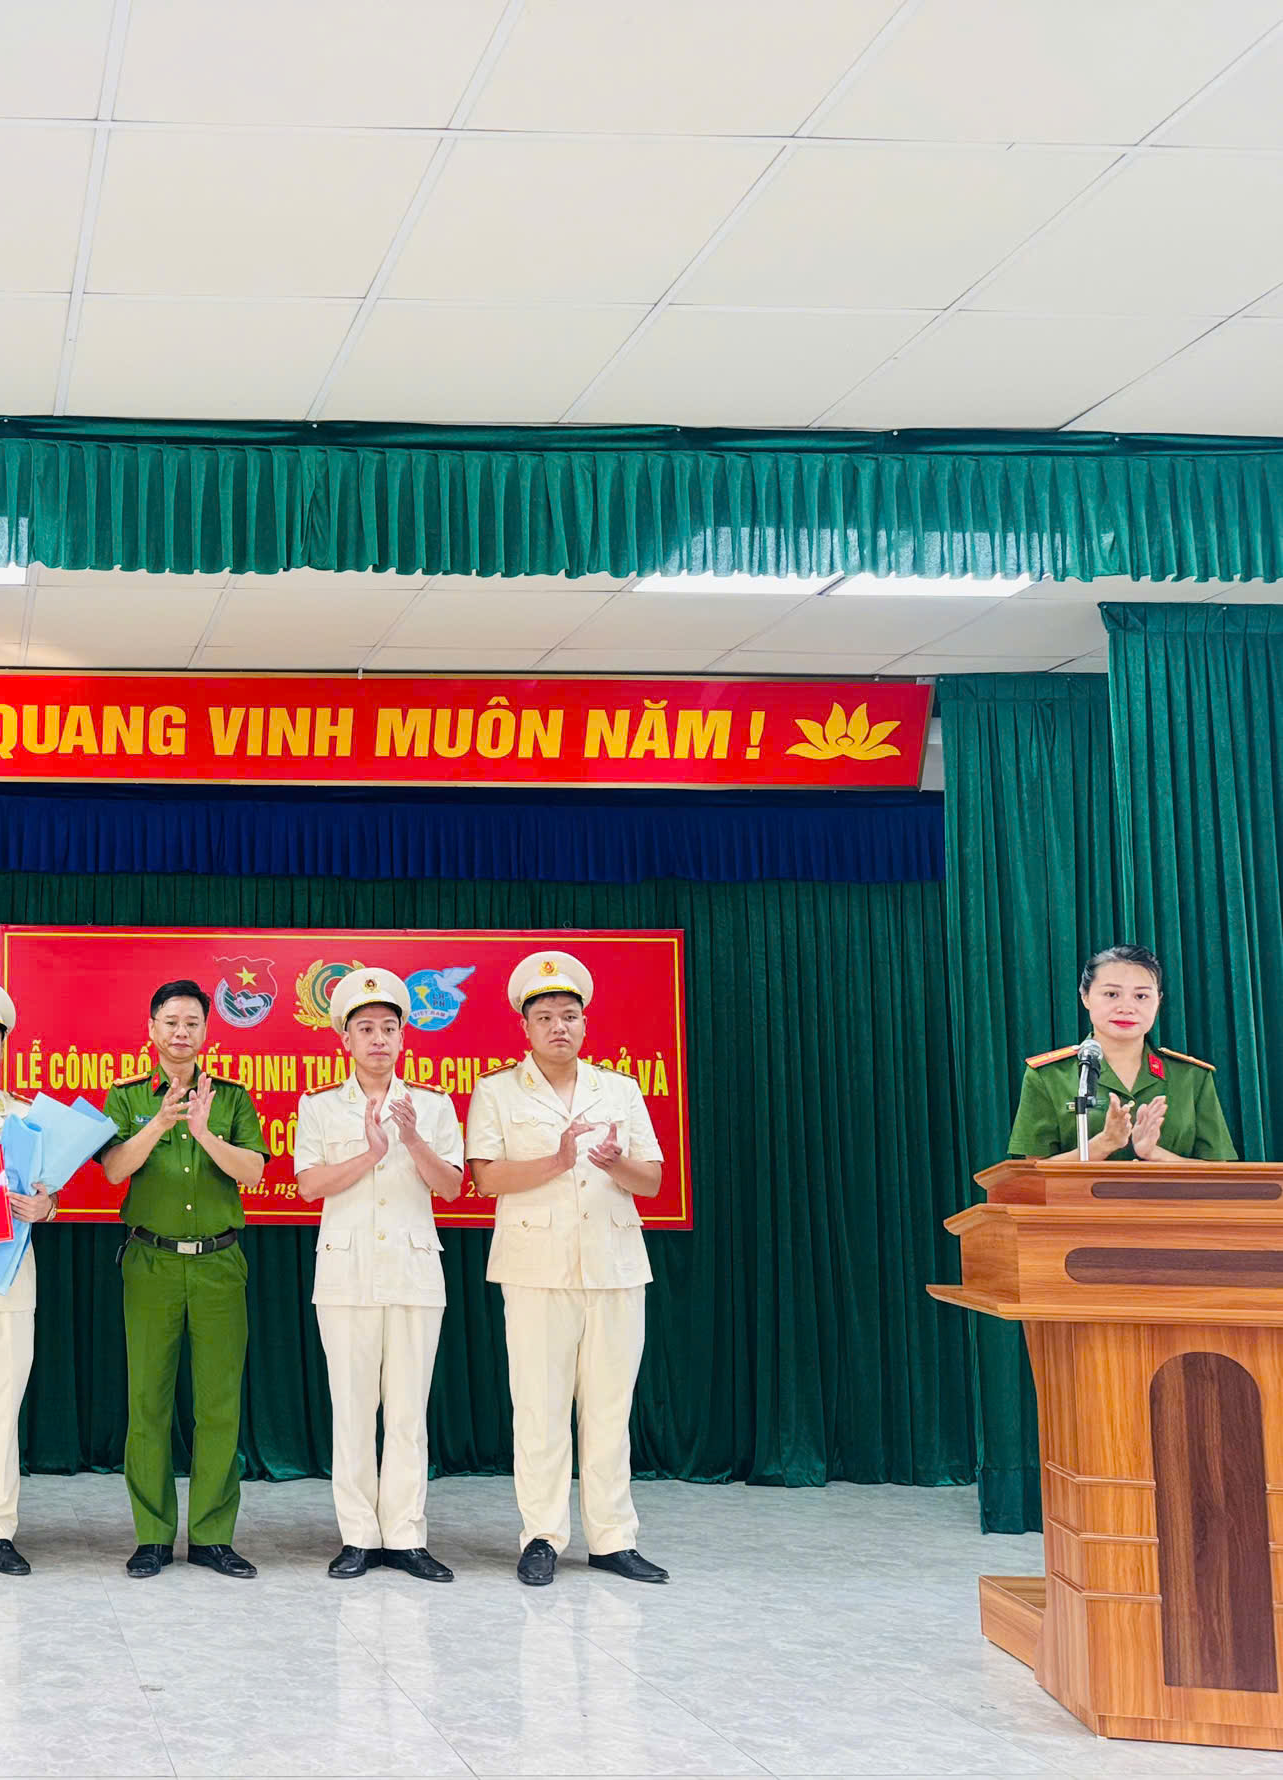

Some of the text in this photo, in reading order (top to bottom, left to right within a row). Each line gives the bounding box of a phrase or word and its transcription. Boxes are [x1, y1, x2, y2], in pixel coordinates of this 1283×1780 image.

[209, 708, 354, 756] VINH
[376, 697, 564, 758] MUÔN
[584, 700, 732, 758] NĂM
[16, 1040, 43, 1089] LỄ
[50, 1045, 114, 1090] CÔNG
[238, 1055, 297, 1100] ĐỊNH
[441, 1057, 480, 1093] CHI
[637, 1052, 669, 1096] VÀ
